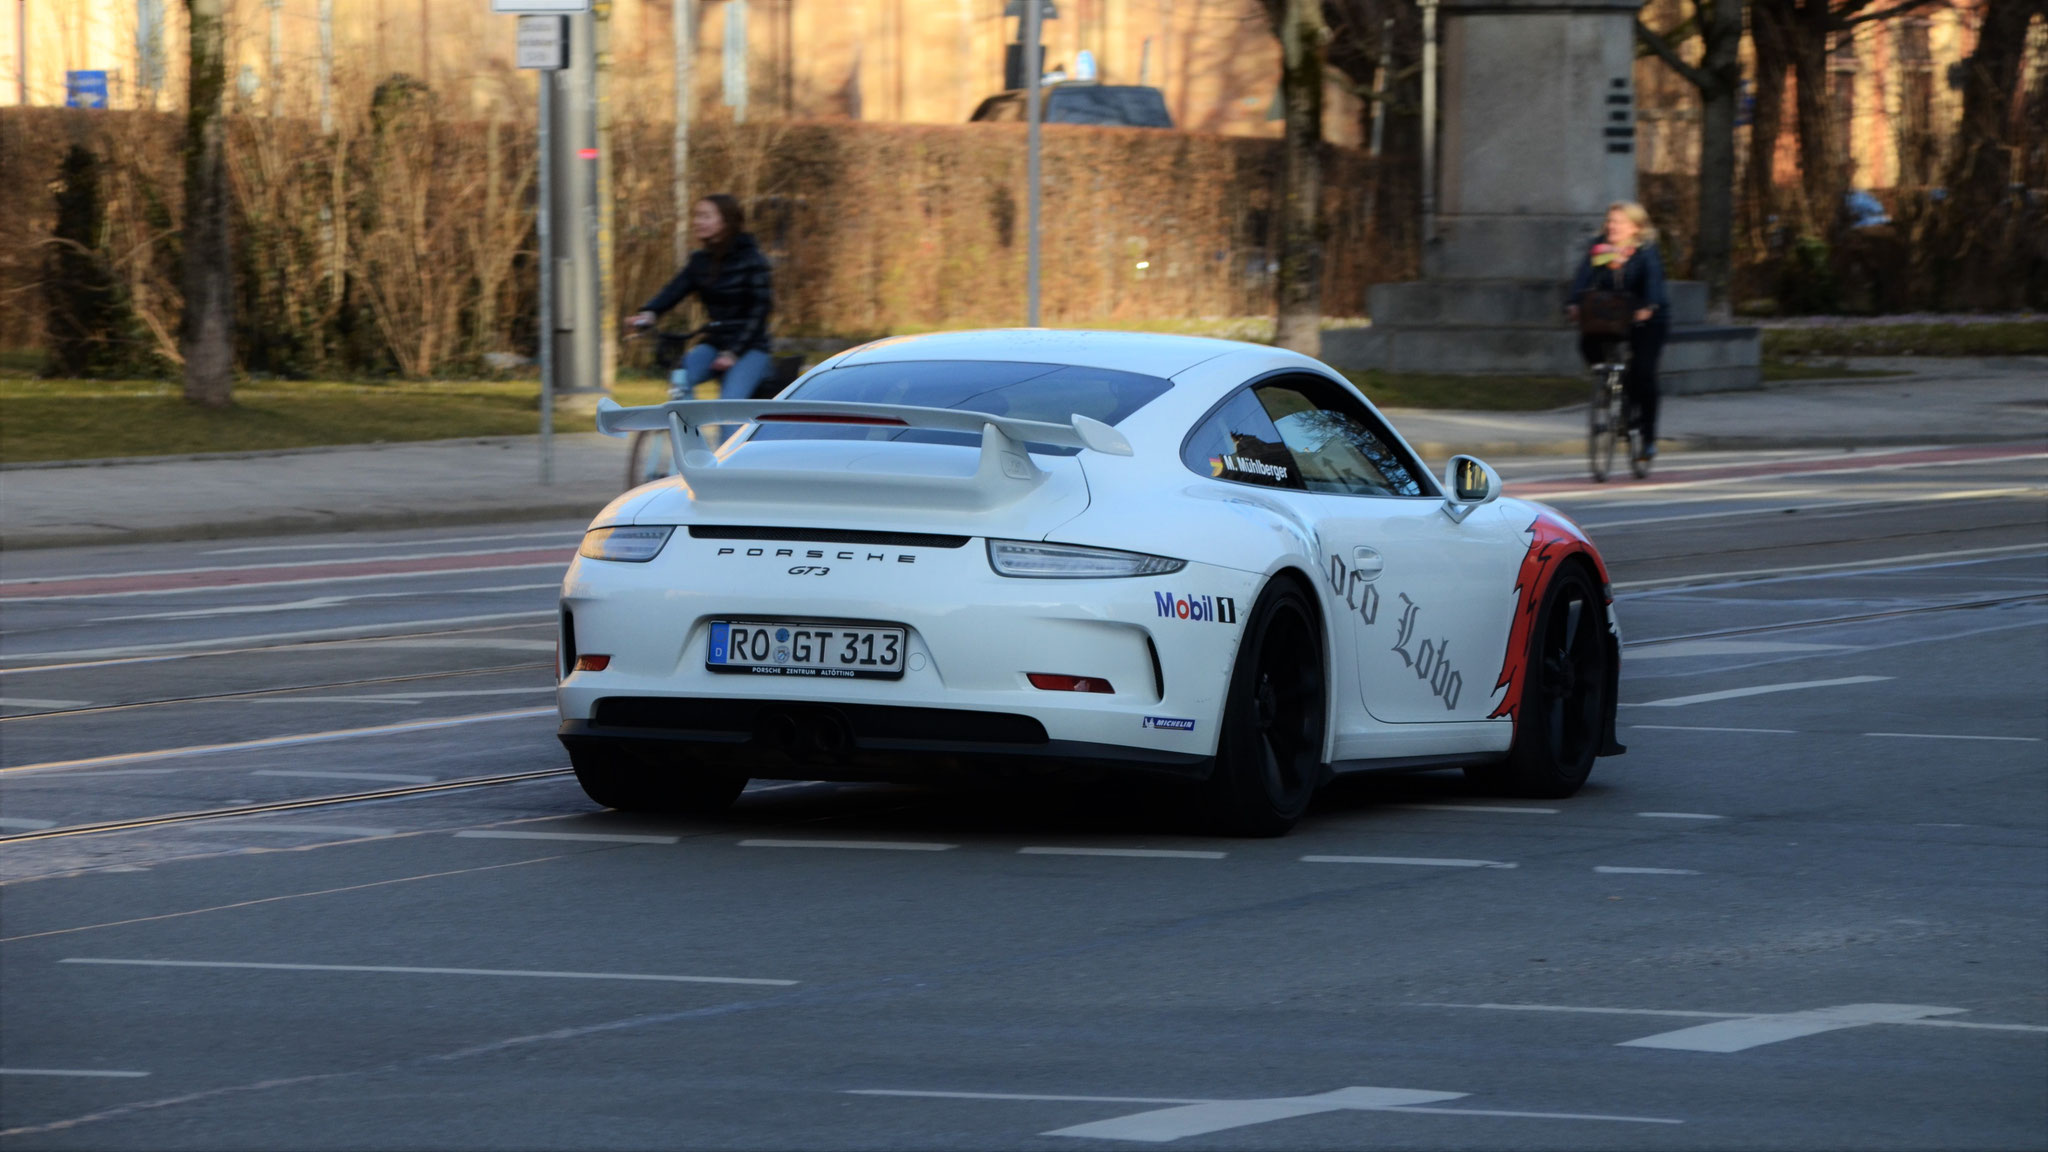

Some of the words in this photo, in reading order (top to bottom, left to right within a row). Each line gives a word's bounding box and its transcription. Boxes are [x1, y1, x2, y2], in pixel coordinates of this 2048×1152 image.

[1223, 455, 1238, 471] M.
[1237, 456, 1288, 481] Mühlberger
[717, 548, 916, 564] PORSCHE
[788, 566, 830, 576] GT3
[1154, 591, 1214, 622] Mobil
[1218, 598, 1234, 624] 1
[715, 648, 723, 657] D
[730, 628, 770, 661] RO
[792, 631, 833, 663] GT
[840, 632, 899, 665] 313
[1391, 592, 1463, 710] Lobo
[752, 666, 781, 674] PORSCHE
[821, 669, 855, 677] ALTÖTTING
[1156, 719, 1193, 728] MICHELIN
